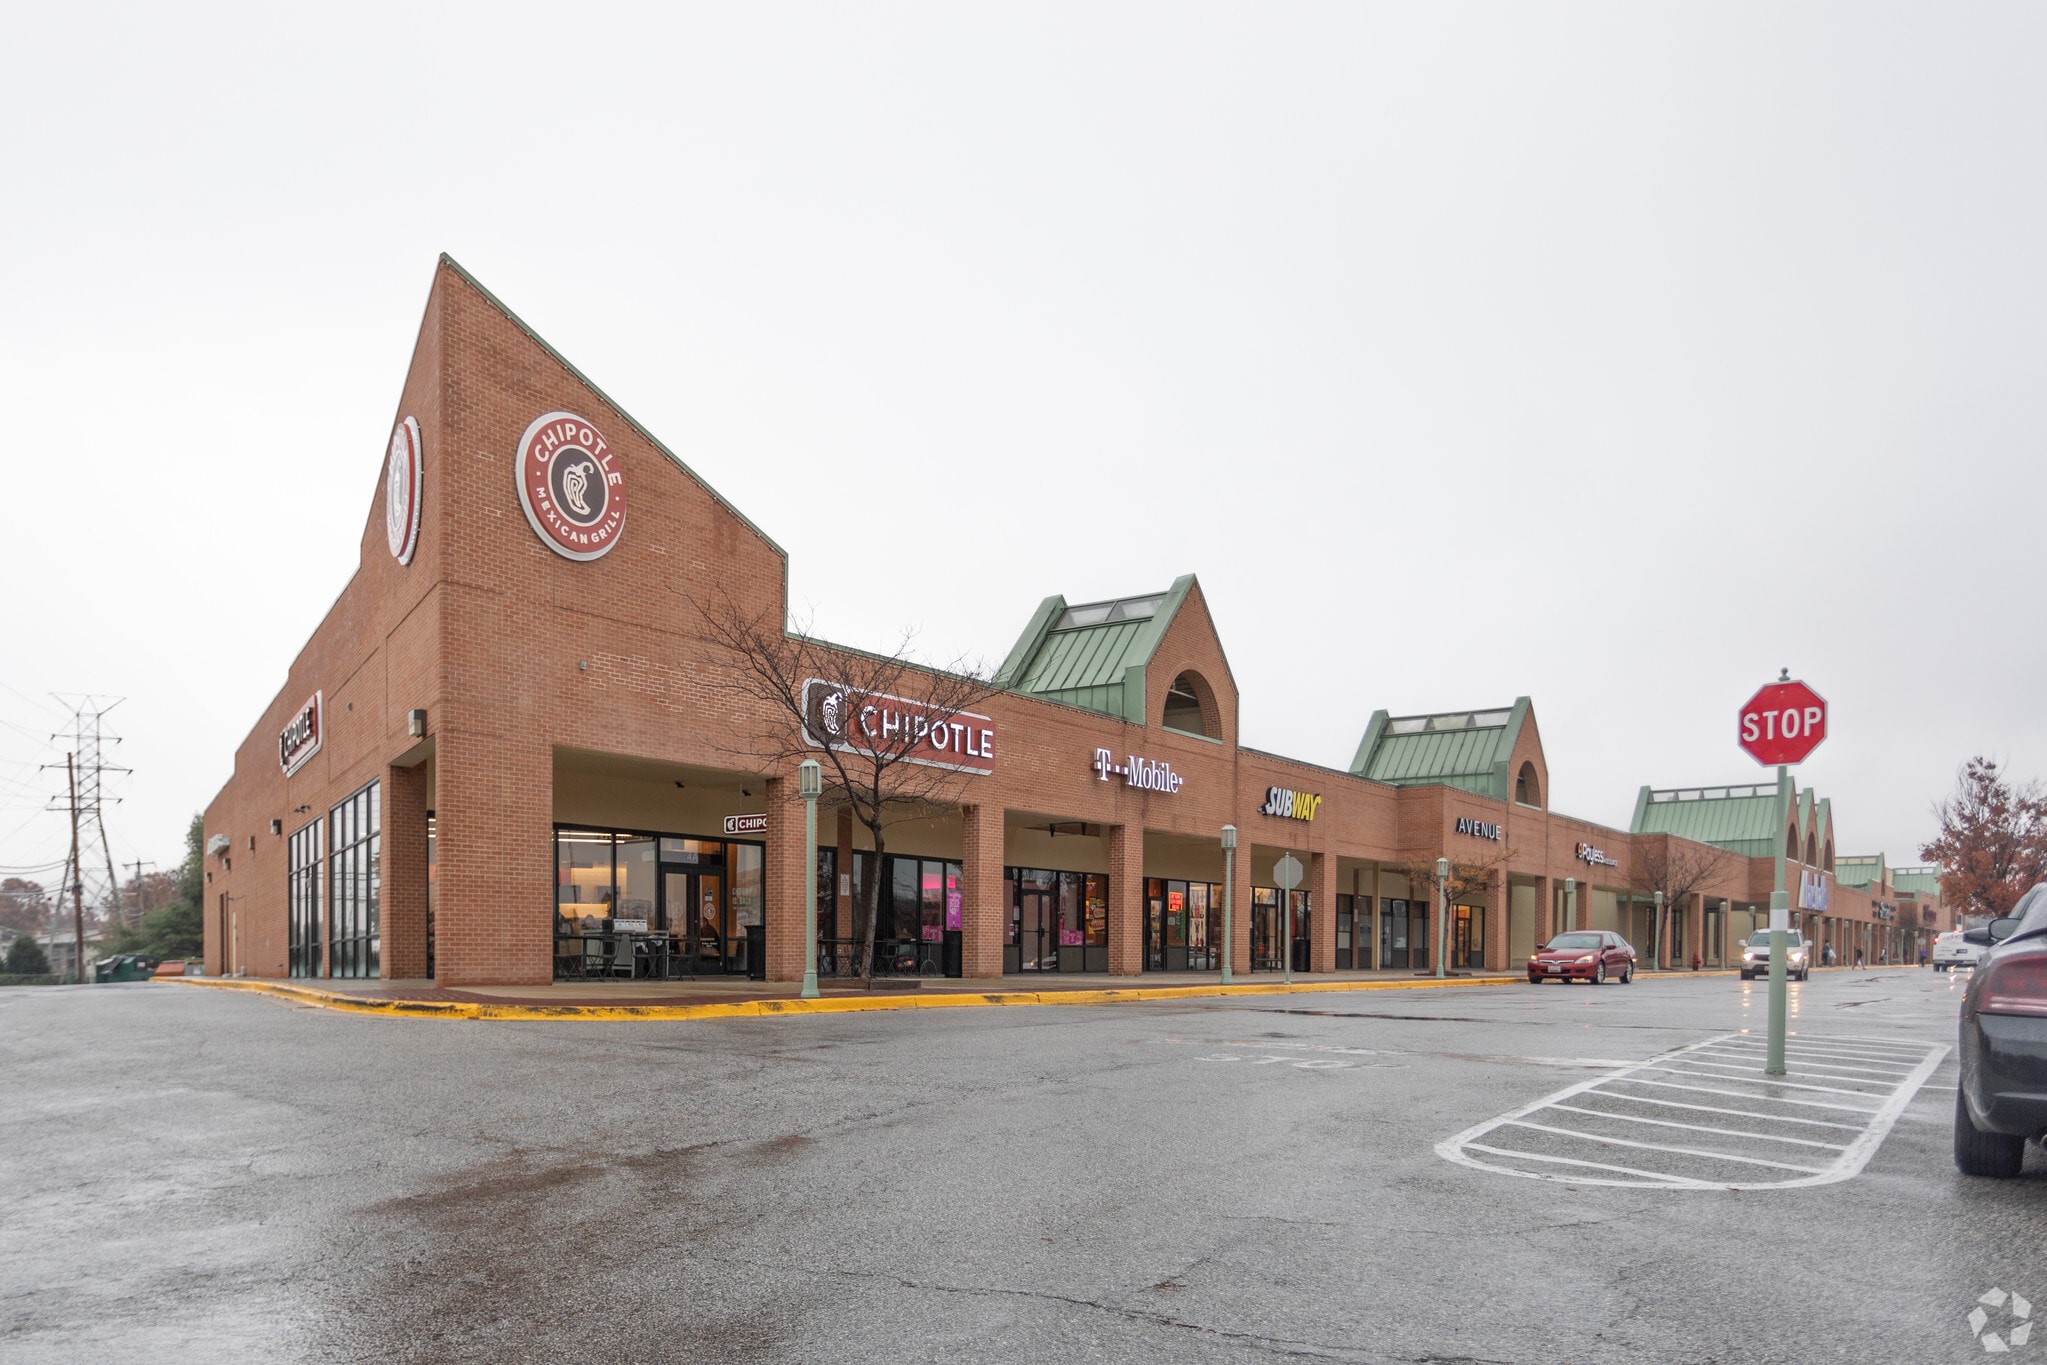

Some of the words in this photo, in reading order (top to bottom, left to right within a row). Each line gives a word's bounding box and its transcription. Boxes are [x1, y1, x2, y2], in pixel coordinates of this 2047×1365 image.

[535, 423, 622, 487] CHIPOTLE
[536, 487, 588, 544] MEXICAN
[591, 511, 620, 543] GRILL
[860, 705, 994, 759] CHIPOTLE
[1742, 707, 1822, 742] STOP
[1262, 786, 1322, 821] SUBWAY
[739, 818, 767, 829] CHIPO
[1458, 817, 1502, 840] AVENUE
